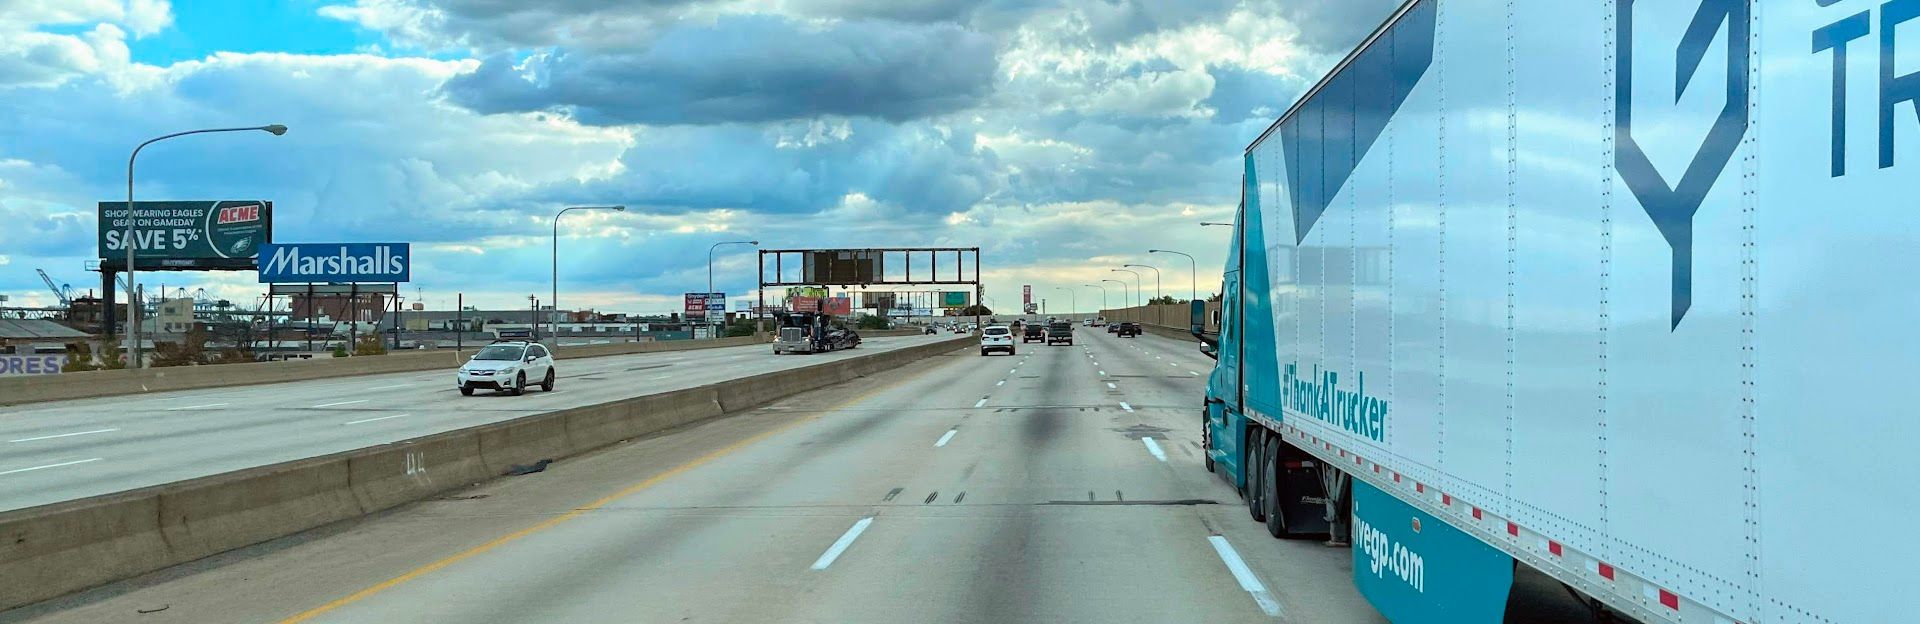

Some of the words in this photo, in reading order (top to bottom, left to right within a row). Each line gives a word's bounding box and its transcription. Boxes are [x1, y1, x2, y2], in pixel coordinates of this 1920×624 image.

[105, 209, 129, 218] SHOP
[132, 209, 171, 218] WEARING
[172, 209, 204, 217] EAGLES
[137, 219, 152, 227] ON
[153, 219, 195, 227] GAMEDAY
[217, 205, 259, 224] ACME
[106, 229, 166, 250] SAVE
[263, 245, 403, 275] Marshalls
[1283, 361, 1387, 443] #ThankATrucker
